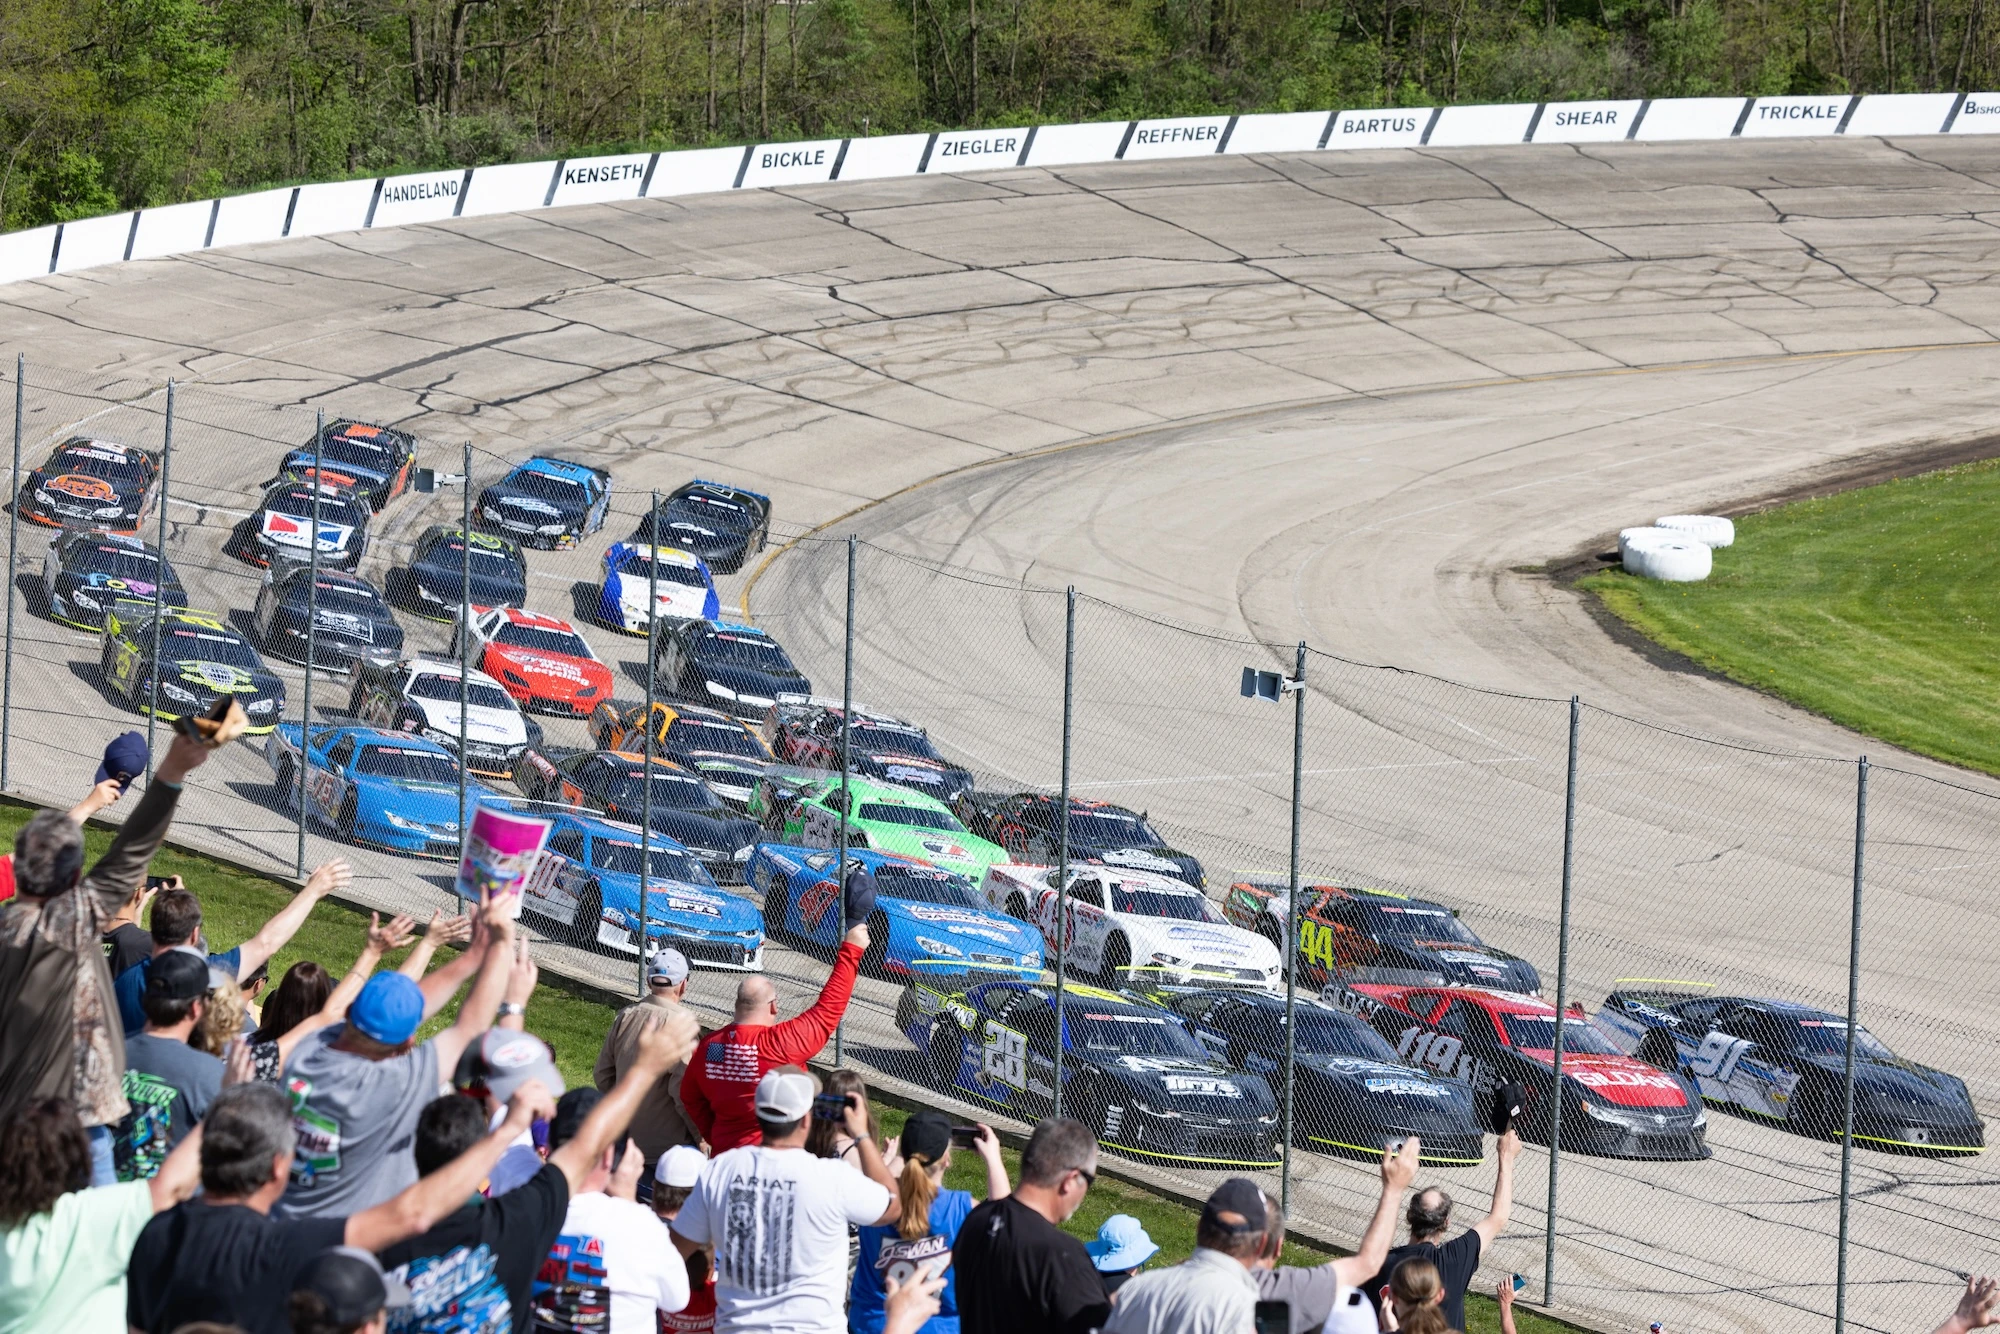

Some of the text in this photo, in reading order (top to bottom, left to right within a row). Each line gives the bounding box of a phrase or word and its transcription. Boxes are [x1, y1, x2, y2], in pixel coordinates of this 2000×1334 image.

[1555, 111, 1617, 126] SHEAR
[1759, 105, 1837, 119] TRICKLE
[1137, 126, 1219, 144] REFFNER
[1343, 118, 1416, 134] BARTUS
[942, 138, 1017, 156] ZIEGLER
[762, 150, 825, 169] BICKLE
[564, 163, 644, 185] KENSETH
[384, 181, 459, 203] HANDELAND
[523, 664, 590, 686] Recycling
[1298, 919, 1335, 971] 44
[1572, 1071, 1682, 1090] GILDAN
[732, 1174, 797, 1191] ARIAT
